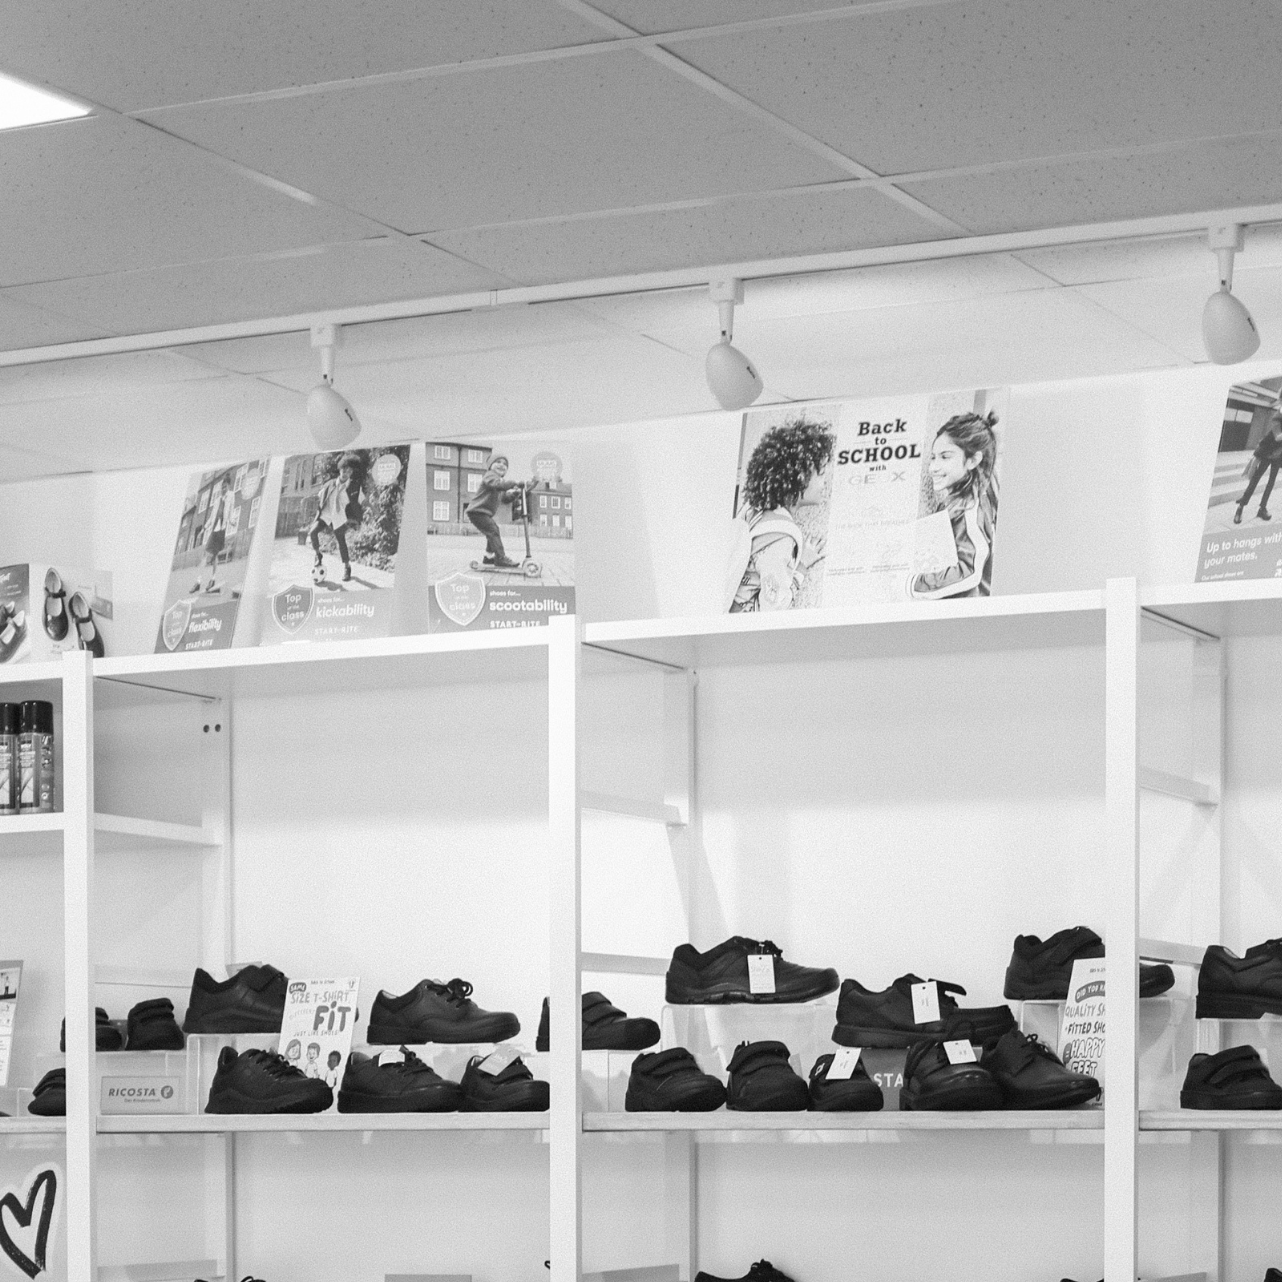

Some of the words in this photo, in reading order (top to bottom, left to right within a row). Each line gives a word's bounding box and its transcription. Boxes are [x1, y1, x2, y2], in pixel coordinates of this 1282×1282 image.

[857, 417, 907, 436] Back
[874, 436, 887, 445] to
[837, 444, 921, 465] SCHOOL
[869, 464, 887, 472] with
[849, 471, 906, 485] GEX
[1206, 542, 1220, 554] Up
[1222, 541, 1231, 550] to
[1233, 537, 1262, 550] hangs
[1204, 556, 1226, 569] your
[1227, 552, 1258, 563] mates.
[450, 584, 470, 593] Top
[285, 593, 302, 604] Top
[316, 601, 375, 620] kickability
[449, 601, 476, 611] class
[489, 599, 568, 614] scootability
[281, 610, 305, 622] class
[188, 619, 222, 634] flexibility
[1070, 1037, 1105, 1059] HAPPY
[108, 1087, 156, 1097] RICOSTA
